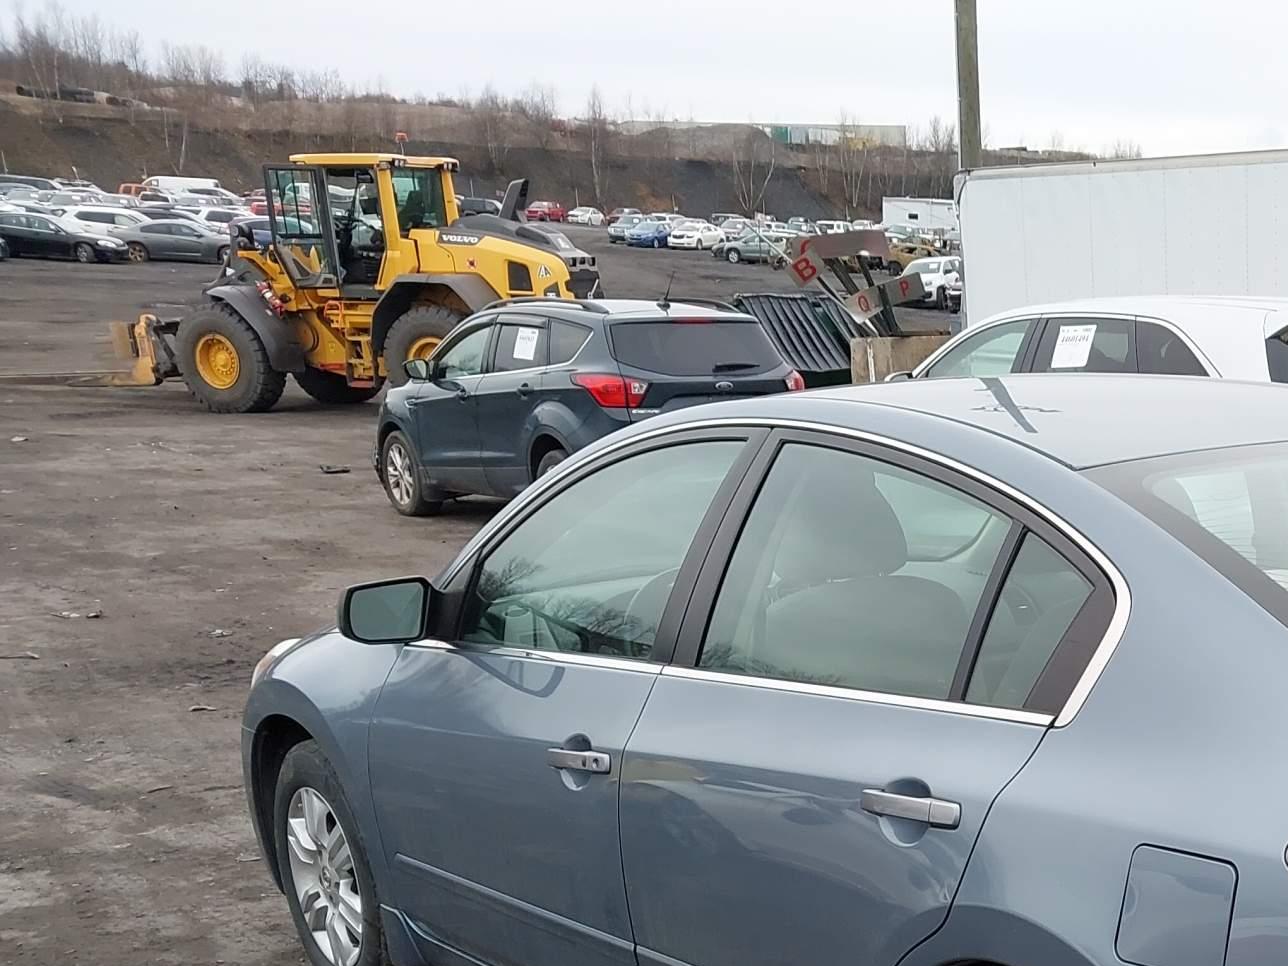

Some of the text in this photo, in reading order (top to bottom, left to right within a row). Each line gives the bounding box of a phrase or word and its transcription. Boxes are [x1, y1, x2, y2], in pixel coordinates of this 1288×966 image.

[442, 234, 479, 243] VOLVO
[792, 258, 817, 282] B
[900, 281, 909, 296] P
[857, 295, 871, 313] Q
